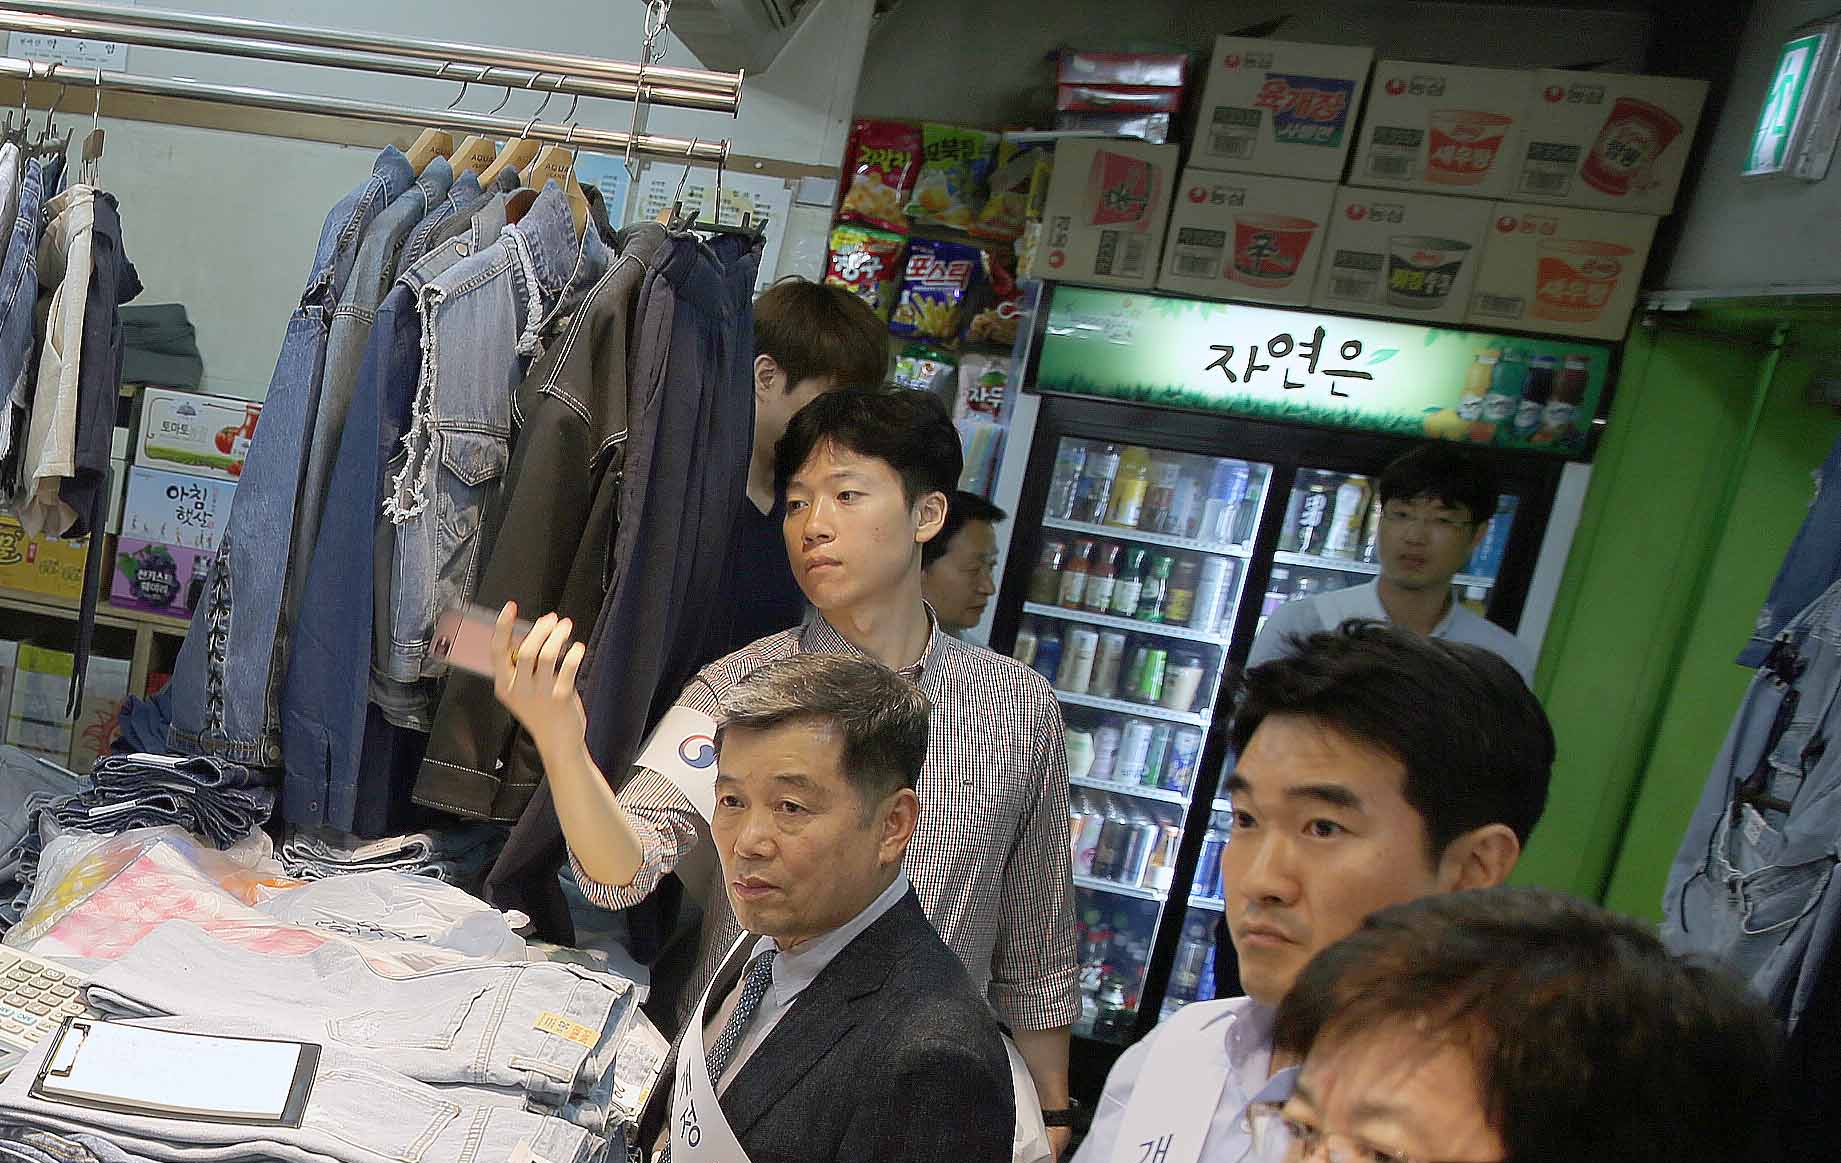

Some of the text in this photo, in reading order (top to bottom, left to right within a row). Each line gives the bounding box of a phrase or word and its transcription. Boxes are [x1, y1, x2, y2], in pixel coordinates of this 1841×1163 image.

[1252, 79, 1346, 122] 육개장
[905, 254, 976, 291] 포스틱
[1205, 325, 1374, 397] 자연은
[160, 420, 191, 436] 토마토
[165, 482, 208, 511] 아침
[175, 505, 215, 530] 햇살
[678, 1055, 702, 1149] 개정
